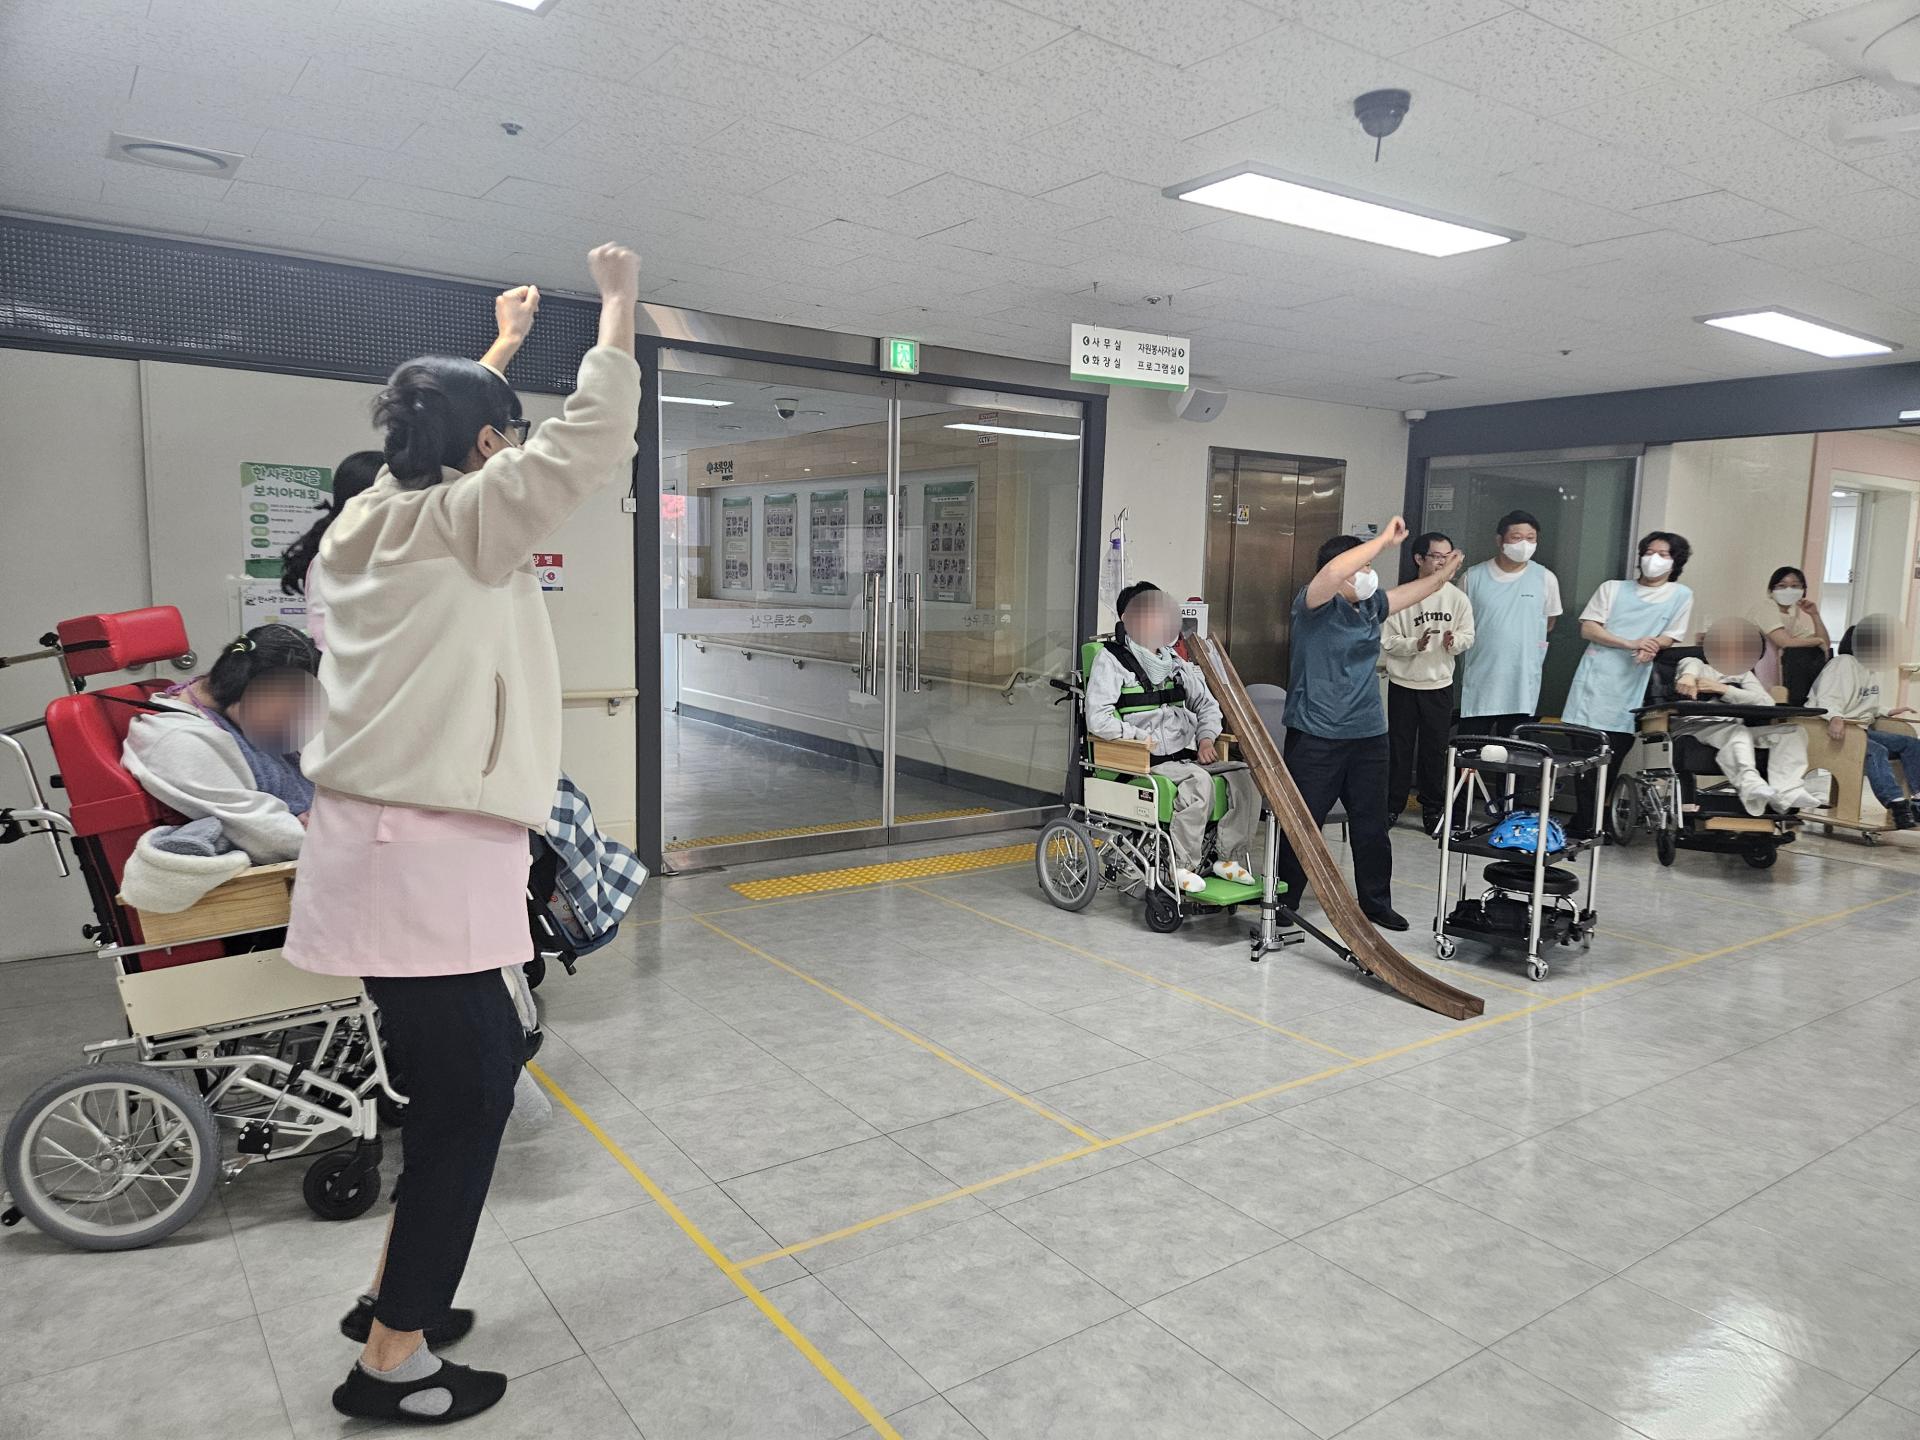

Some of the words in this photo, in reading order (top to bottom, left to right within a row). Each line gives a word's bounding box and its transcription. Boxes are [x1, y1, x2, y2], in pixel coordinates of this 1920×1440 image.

[1137, 343, 1177, 358] 자원봉사자실
[1137, 361, 1177, 375] 프로그램실
[252, 465, 320, 485] 한사랑마을
[254, 485, 320, 502] 보치아대회
[1181, 608, 1197, 616] AED
[1413, 610, 1452, 627] ritmo
